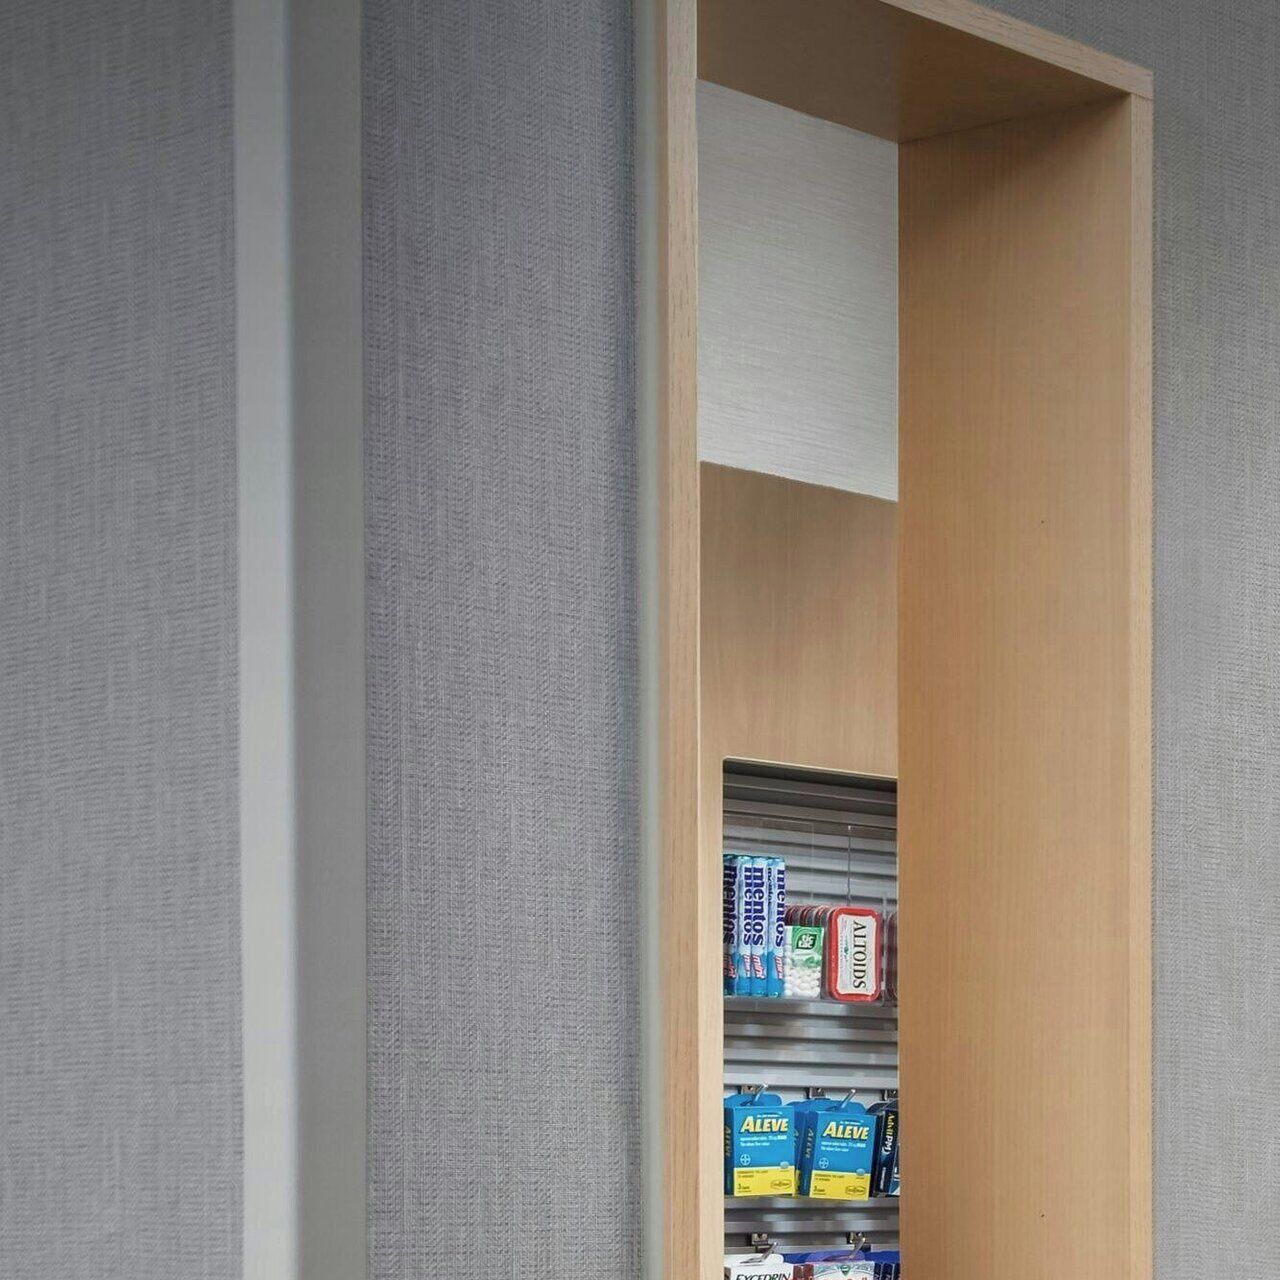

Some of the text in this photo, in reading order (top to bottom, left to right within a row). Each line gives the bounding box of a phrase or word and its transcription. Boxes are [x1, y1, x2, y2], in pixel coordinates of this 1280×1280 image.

[752, 867, 766, 946] mentos
[852, 920, 867, 989] ALTOIDS
[740, 1115, 790, 1133] ALEVE
[822, 1121, 870, 1140] ALEVE
